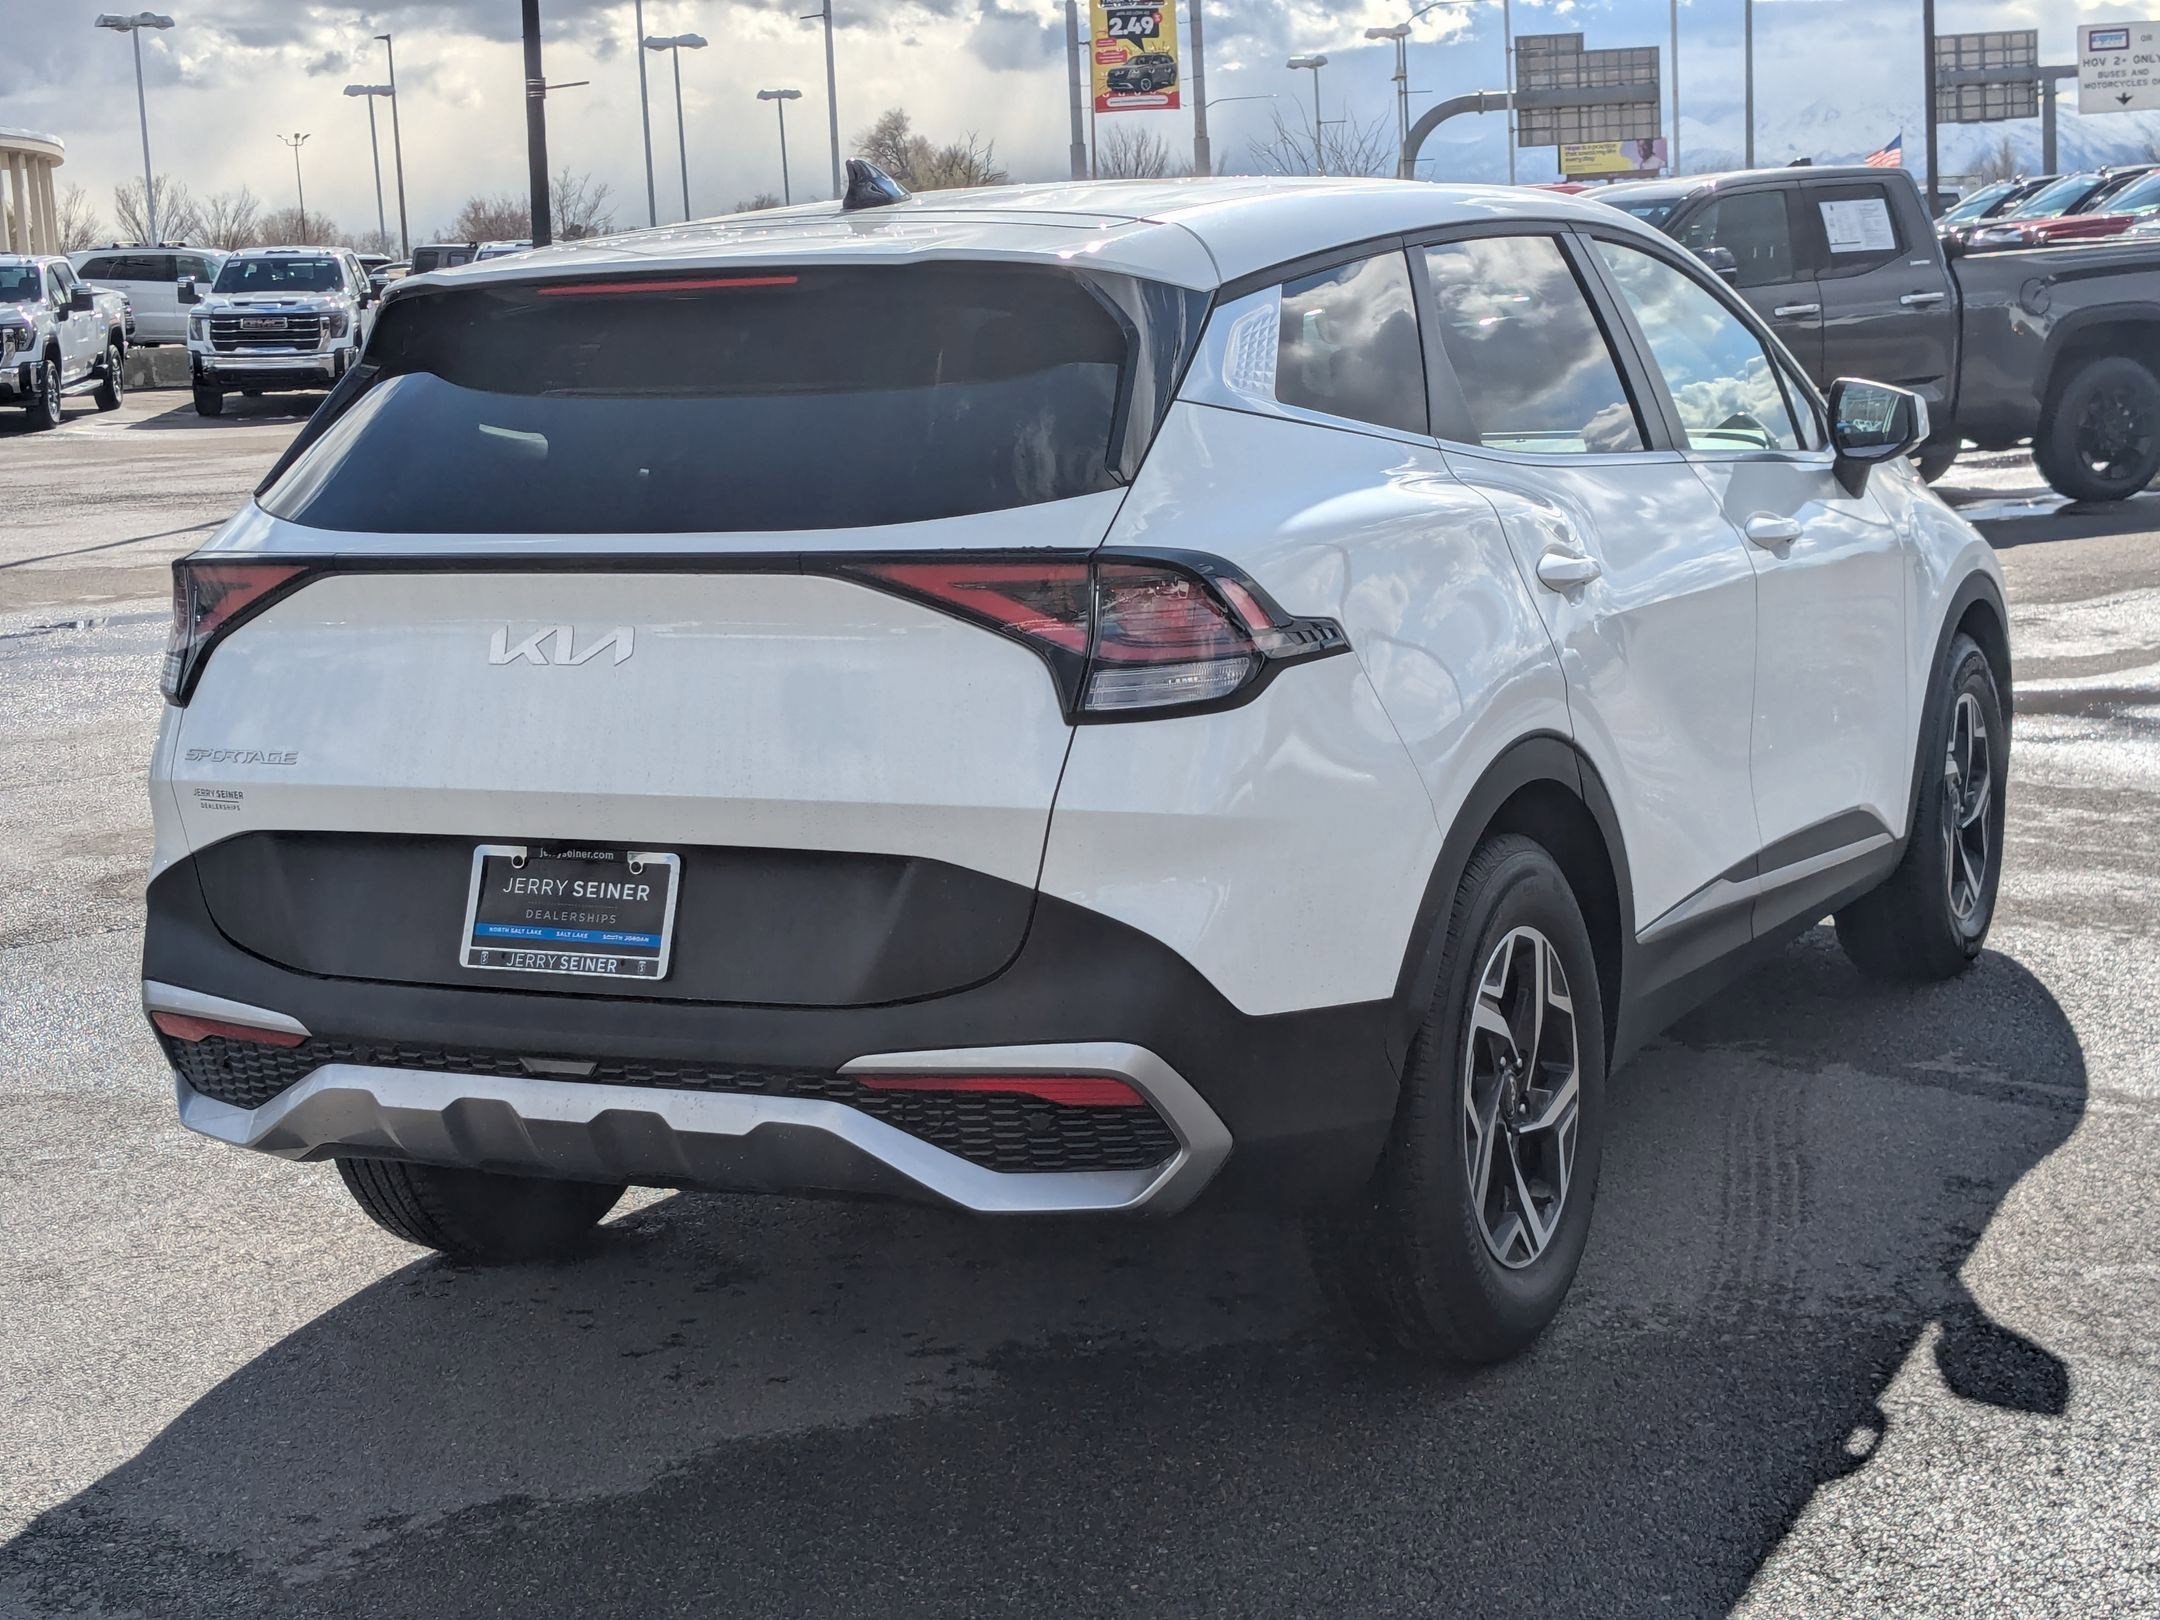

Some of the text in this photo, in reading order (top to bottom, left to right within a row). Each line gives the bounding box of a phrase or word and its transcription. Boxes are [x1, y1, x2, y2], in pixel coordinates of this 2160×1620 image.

[1109, 16, 1154, 35] 2.49
[2140, 34, 2153, 42] OR
[2083, 57, 2106, 67] HOV
[2133, 54, 2160, 64] ONLY
[2098, 68, 2149, 79] BUSES AND
[2084, 78, 2148, 89] MOTORCYCLES
[243, 319, 285, 328] GMC
[488, 625, 635, 666] KIA
[184, 747, 299, 766] SPORTAGE
[194, 787, 244, 800] JERRY SEINER
[200, 802, 240, 811] DEALERSHIPS
[502, 877, 650, 901] JERRY SEINER
[526, 909, 617, 924] DEALERSHIPS
[506, 952, 617, 973] JERRY SEINER
